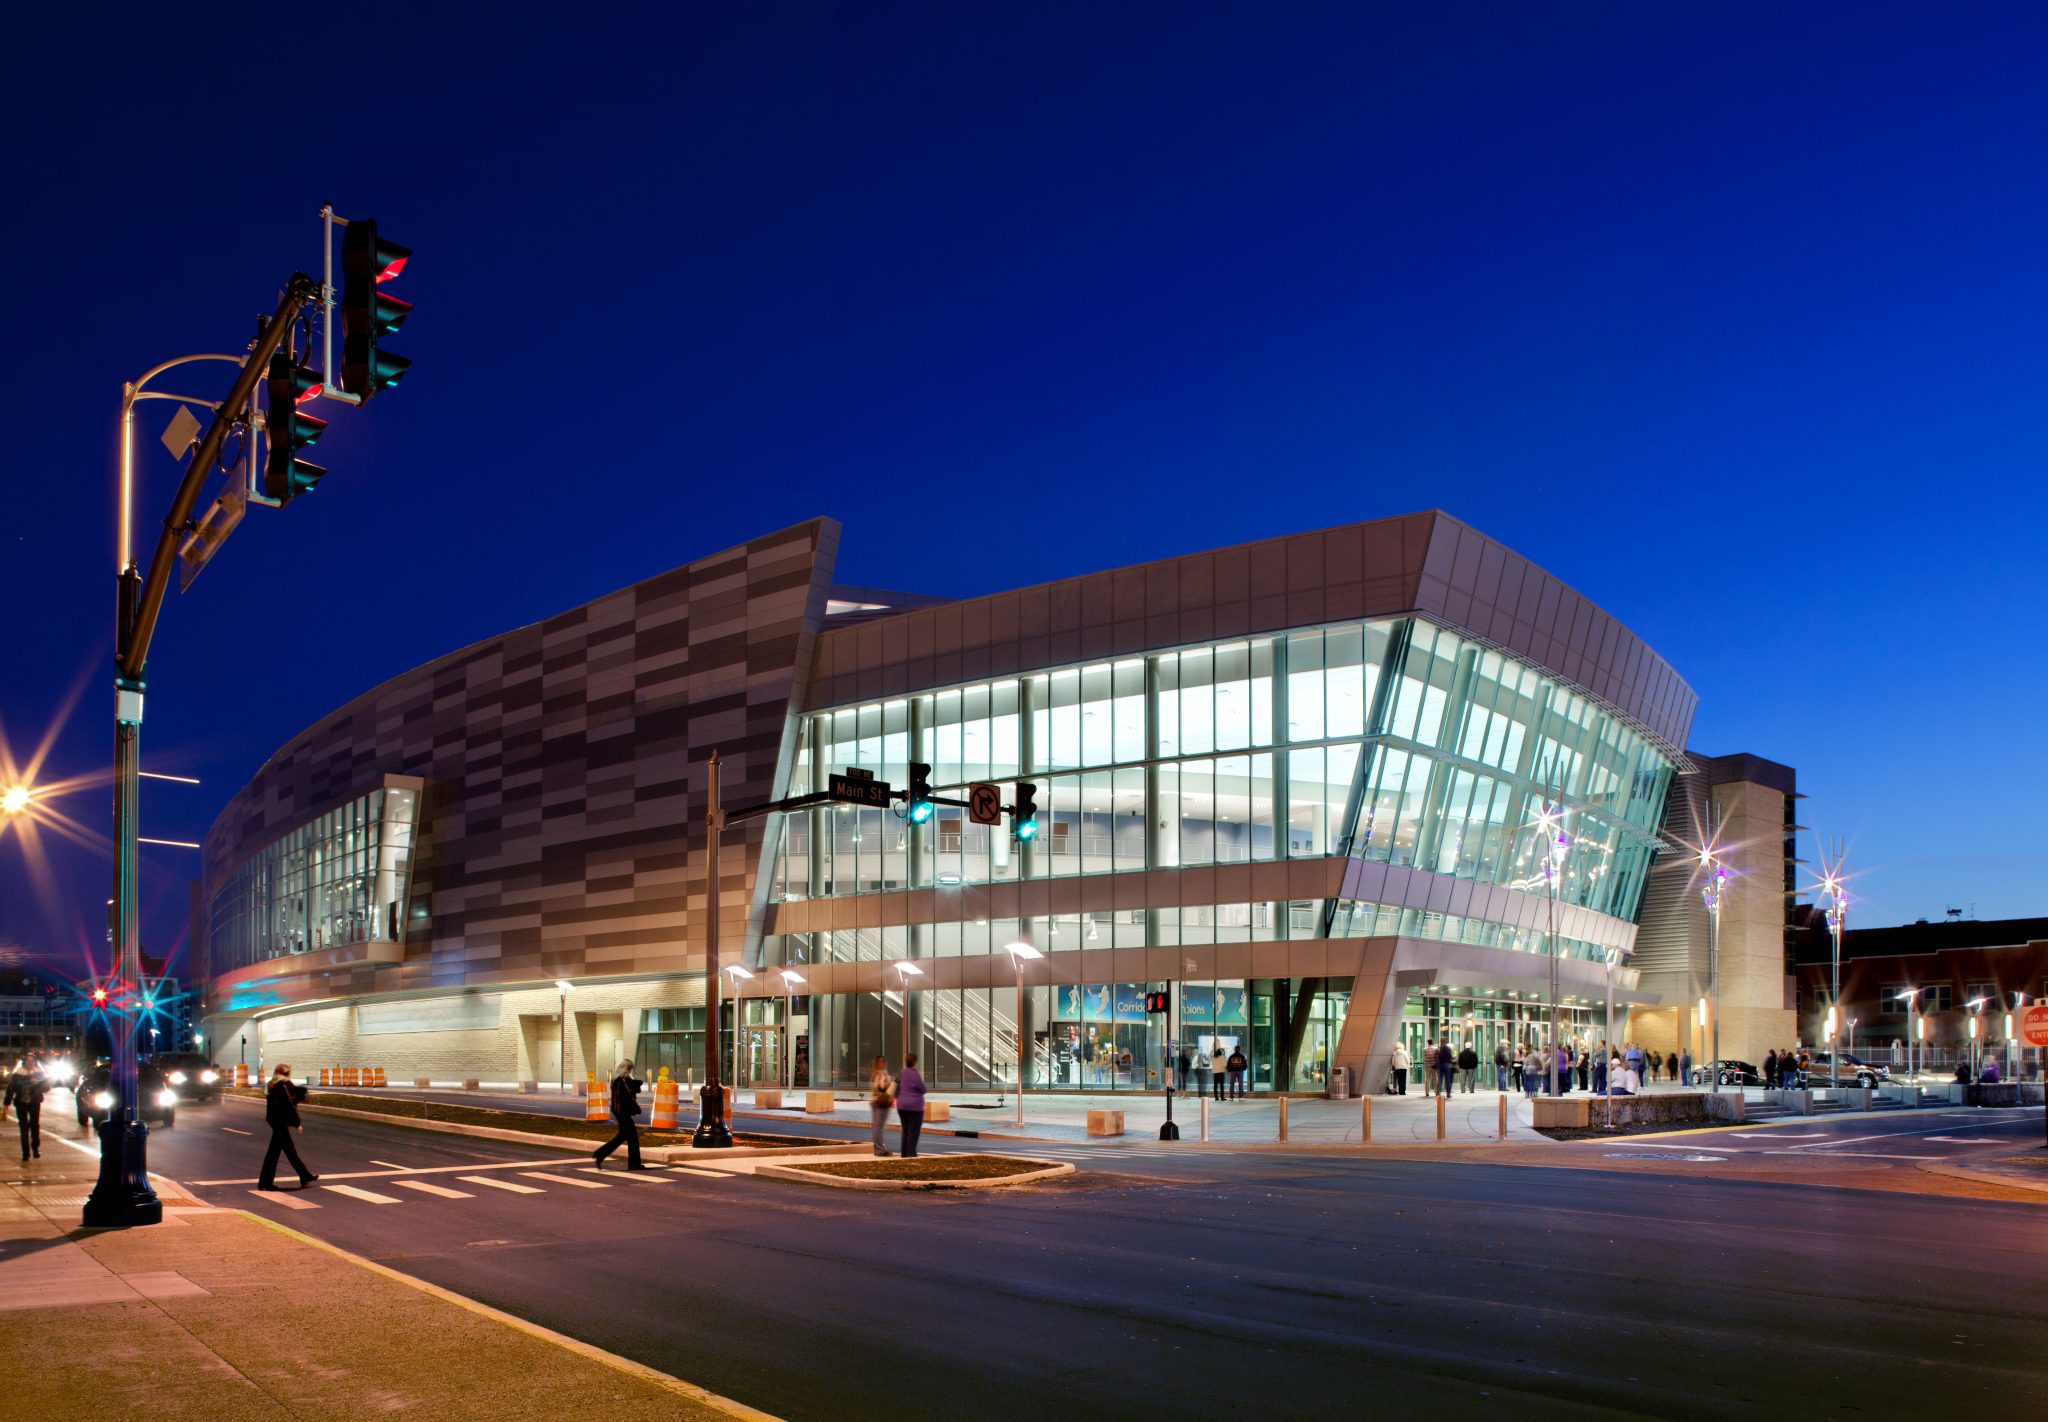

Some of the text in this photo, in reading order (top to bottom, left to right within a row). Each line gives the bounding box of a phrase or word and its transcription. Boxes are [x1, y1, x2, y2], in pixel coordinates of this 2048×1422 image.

[837, 782, 883, 800] Main St
[2028, 1014, 2039, 1022] DO
